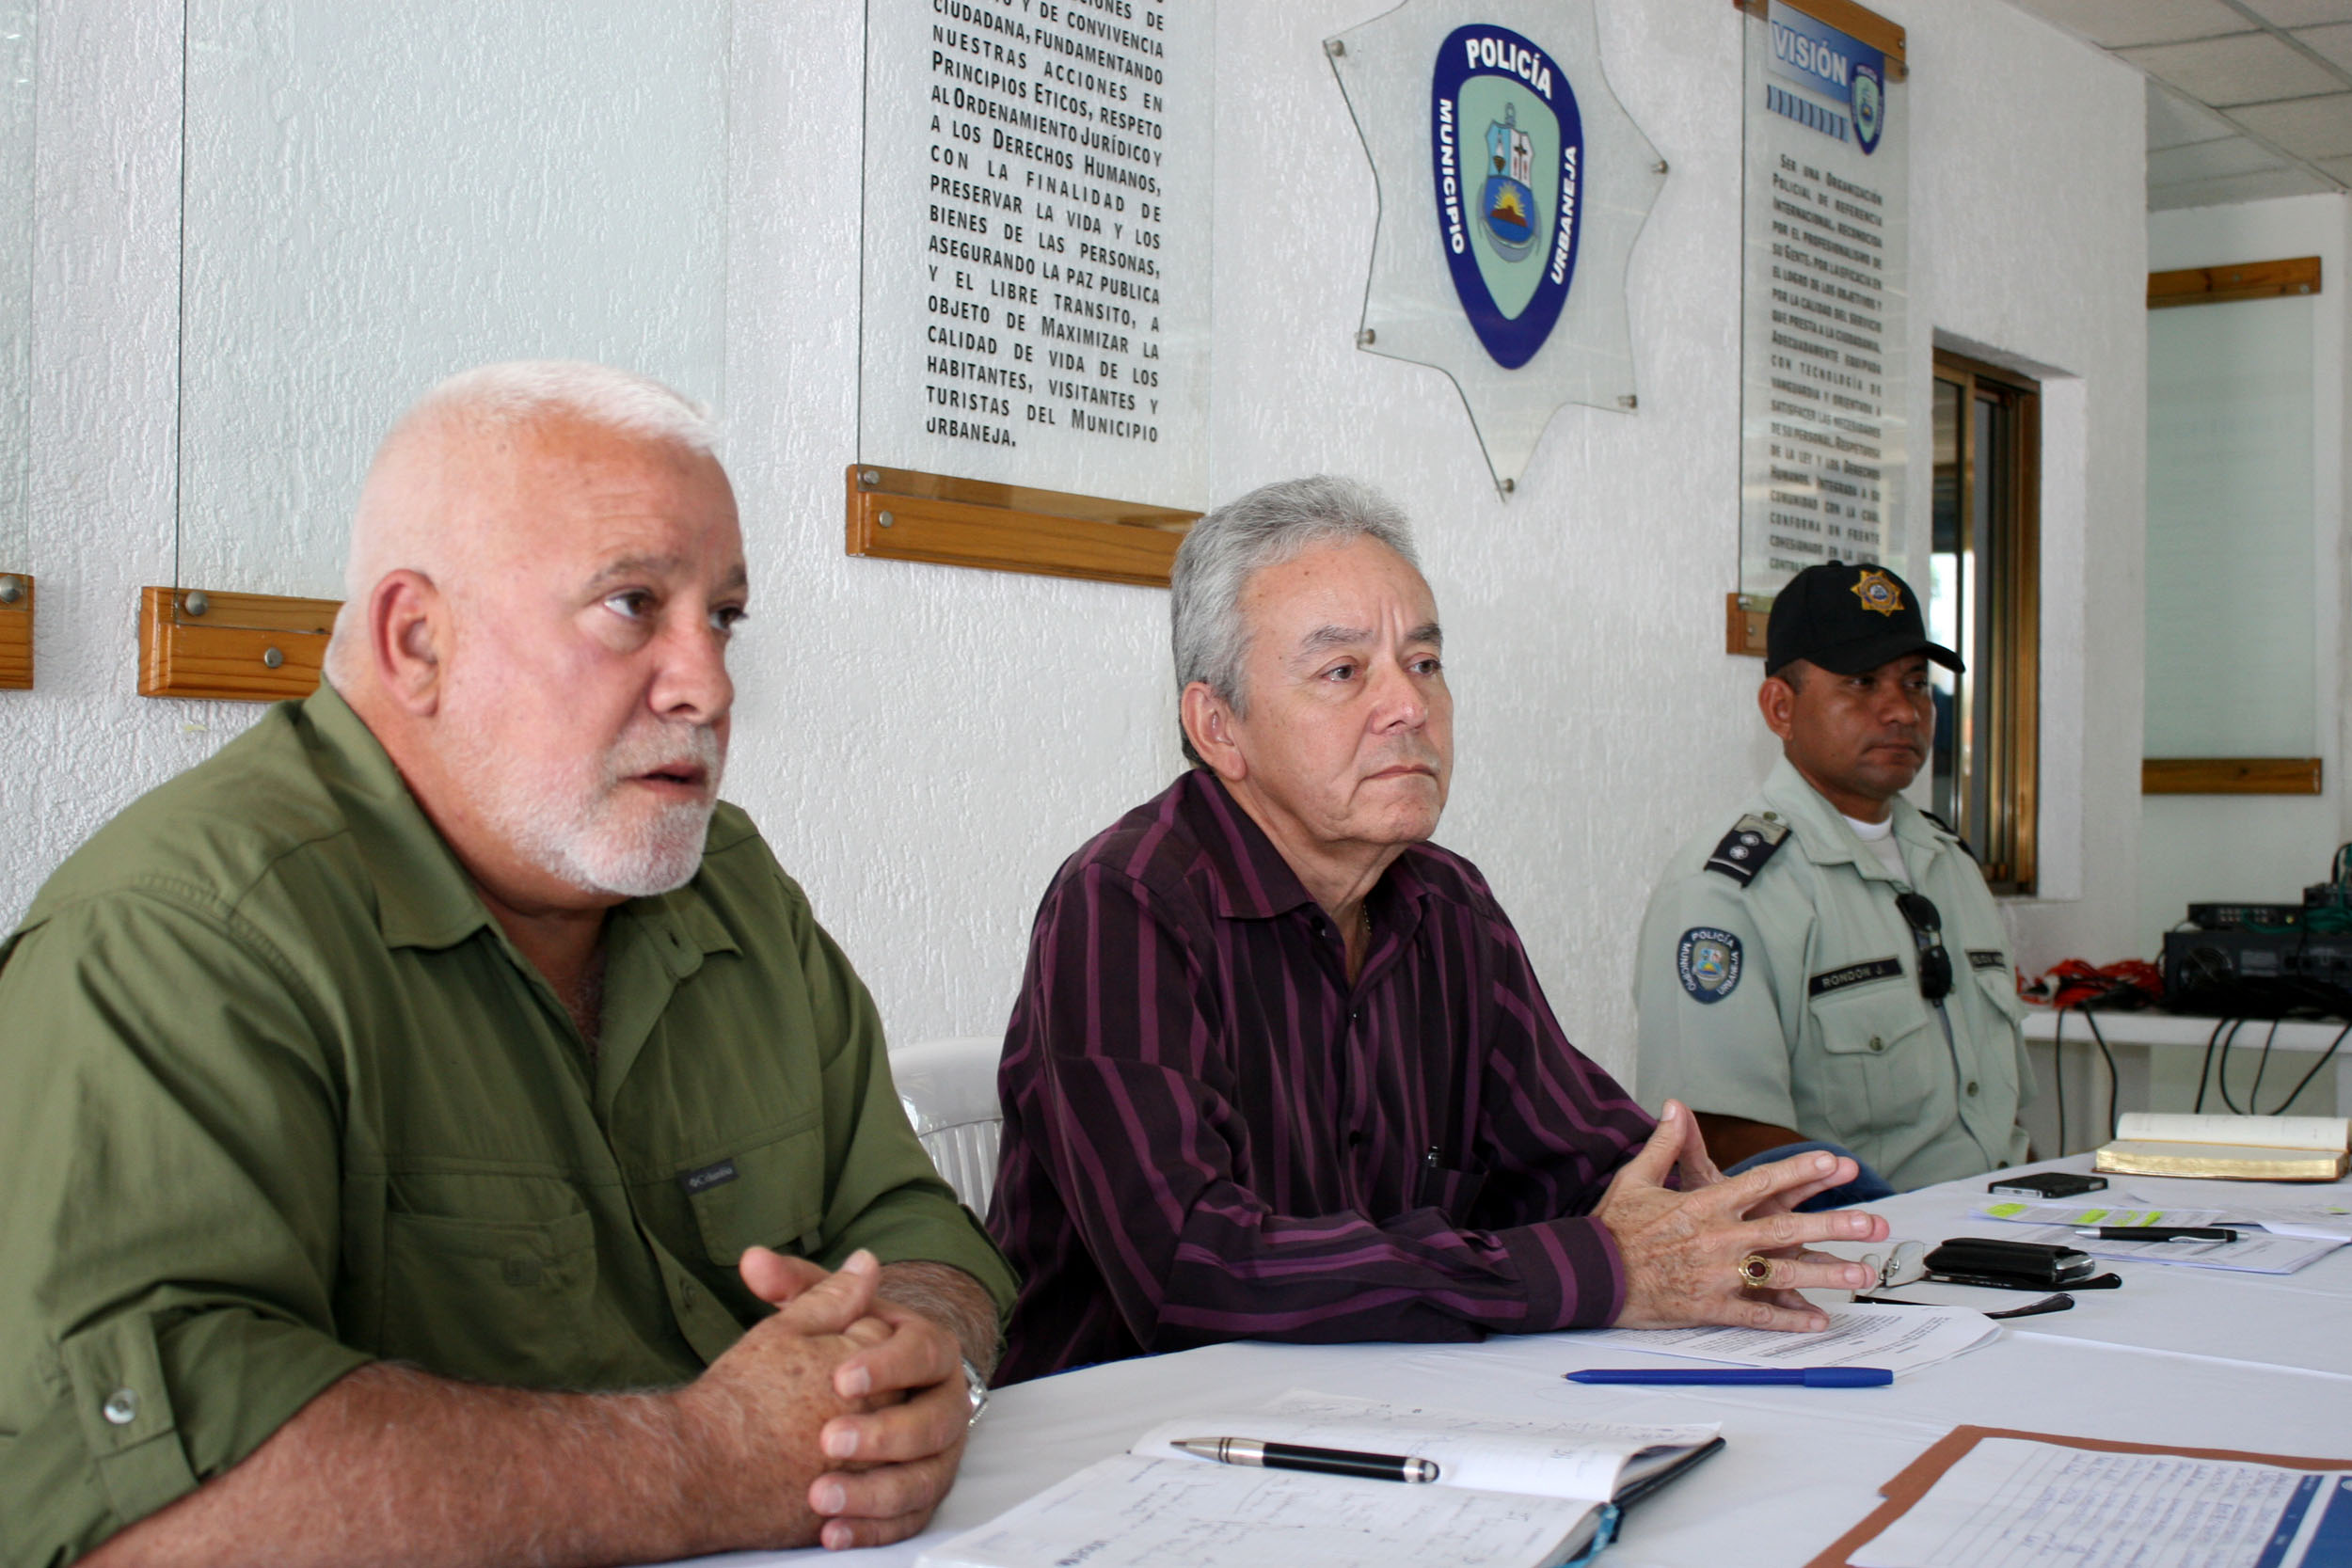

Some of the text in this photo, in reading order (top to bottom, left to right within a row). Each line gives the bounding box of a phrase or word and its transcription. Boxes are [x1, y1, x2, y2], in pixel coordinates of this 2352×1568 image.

[932, 0, 1164, 86] CIUDADANA, FUNDAMENTANDO
[1040, 1, 1058, 24] DE
[1066, 10, 1164, 59] CONVIVENCIA
[1146, 10, 1164, 32] DE
[1772, 21, 1848, 87] VISIÓN
[931, 50, 1027, 99] PRINCIPIOS
[1100, 106, 1163, 141] RESPETO
[932, 24, 1163, 114] NUESTRAS ACCIONES EN
[1466, 38, 1552, 101] POLICÍA
[930, 84, 1163, 167] AL ORDENAMIENTO JURÍDICO Y
[930, 114, 1162, 198] A LOS DERECHOS HUMANOS,
[930, 144, 1162, 223] CON LA FINALIDAD DE
[930, 173, 1161, 250] PRESERVAR LA VIDA Y LOS
[1439, 99, 1465, 254] MUNICIPIO
[930, 203, 1160, 279] BIENES DE LAS PERSONAS,
[1550, 146, 1577, 285] URBANEJA
[928, 234, 1160, 306] ASEGURANDO LA PAZ PUBLICA
[928, 263, 1160, 333] Y EL LIBRE TRANSITO, A
[927, 325, 1159, 388] CALIDAD DE VIDA DE LOS
[928, 294, 1160, 360] OBJETO DE MAXIMIZAR LA
[925, 385, 1158, 443] TURISTAS DEL MUNICIPIO
[927, 355, 1159, 415] HABITANTES, VISITANTES Y
[926, 416, 1017, 448] URBANEJA.
[1679, 942, 1697, 991] MUNICIPIO
[1691, 931, 1735, 948] POLICÍA
